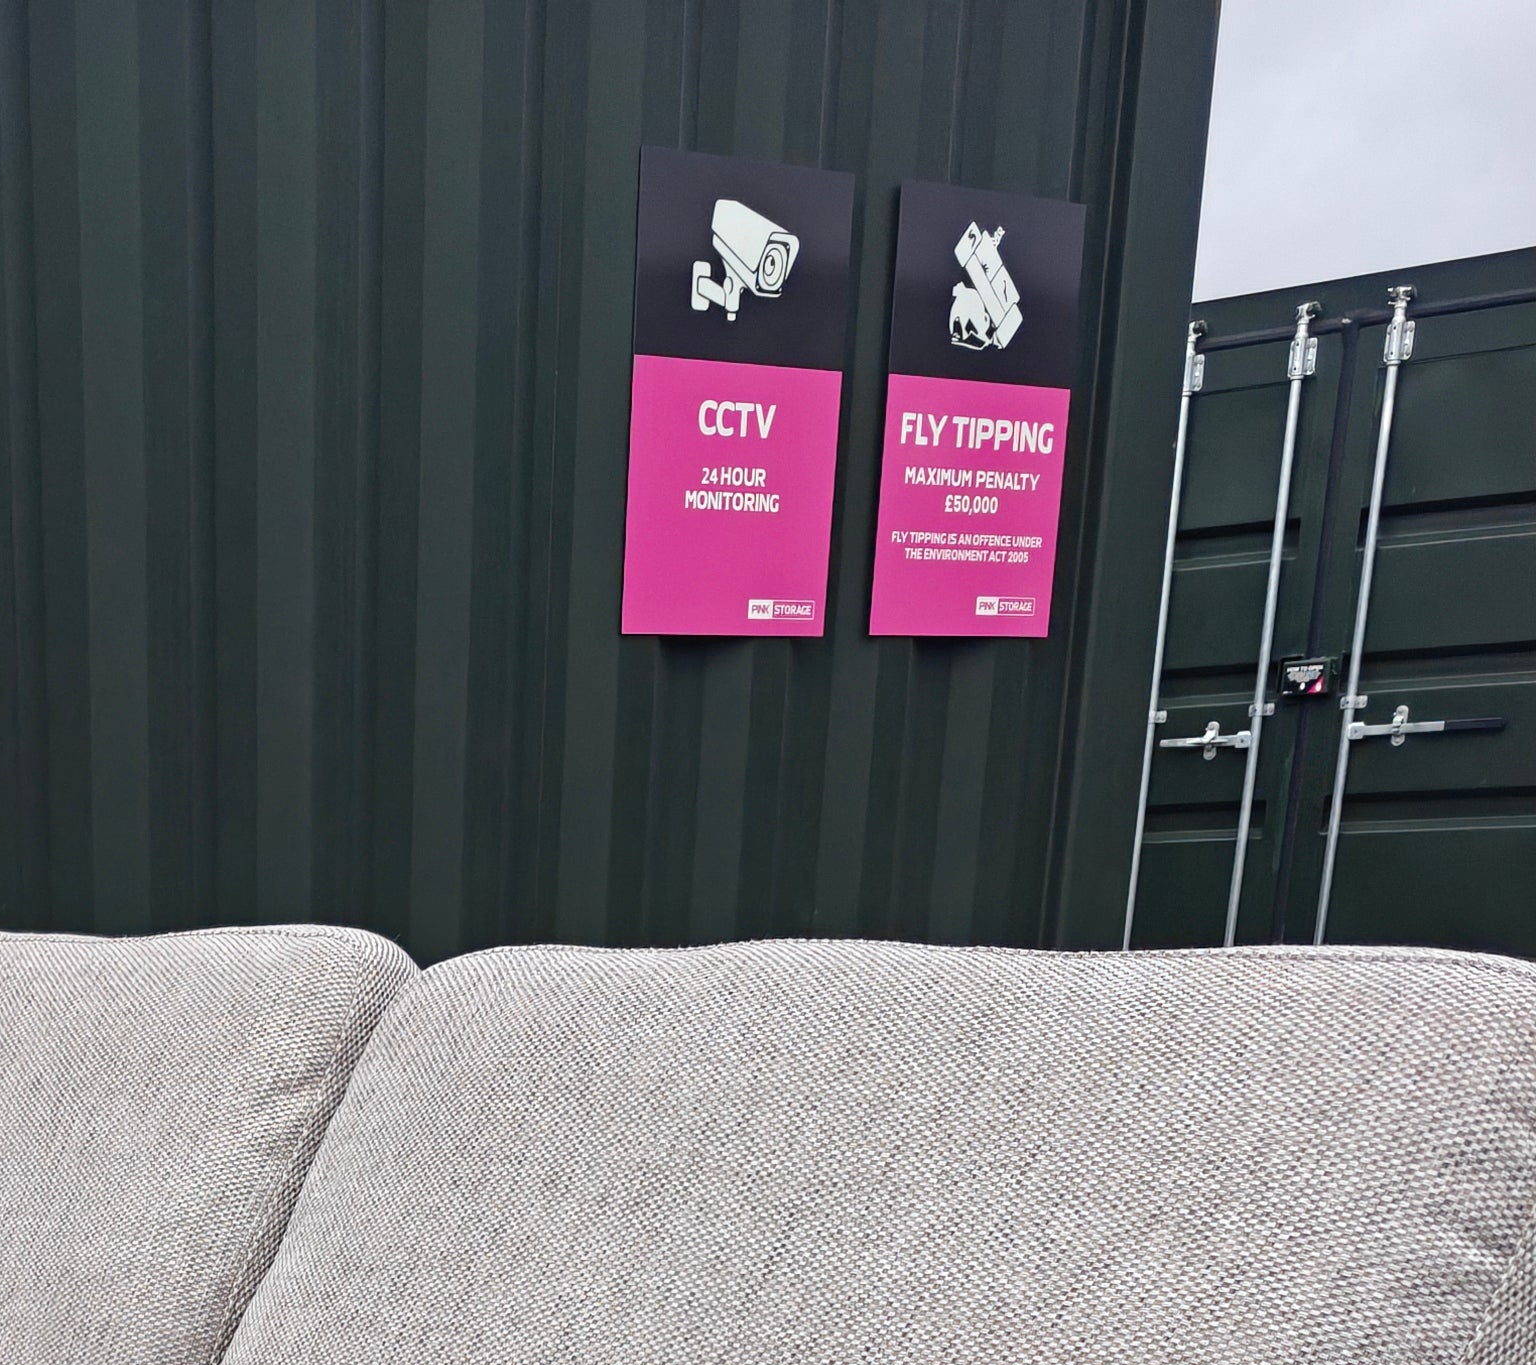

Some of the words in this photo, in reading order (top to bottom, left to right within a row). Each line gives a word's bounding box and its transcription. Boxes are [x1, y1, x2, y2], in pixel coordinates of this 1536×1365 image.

[698, 399, 777, 439] CCTV
[900, 411, 949, 447] FLY
[952, 415, 1055, 455] TIPPING
[700, 466, 719, 485] 24
[720, 466, 766, 488] HOUR
[904, 466, 973, 488] MAXIMUM
[975, 470, 1041, 491] PENALTY
[684, 490, 780, 513] MONITORING
[944, 494, 999, 516] £50,000
[891, 530, 909, 544] FLY
[909, 531, 947, 545] TIPPING
[947, 532, 957, 545] IS
[957, 533, 972, 546] AN
[972, 534, 1012, 547] OFFENCE
[1012, 536, 1043, 548] UNDER
[904, 547, 923, 560] THE
[923, 548, 989, 562] ENVIRONMENT
[988, 550, 1007, 562] ACT
[1007, 551, 1029, 563] 2005
[751, 604, 770, 615] PINK
[773, 604, 813, 616] STORAGE
[999, 601, 1033, 612] STORAGE
